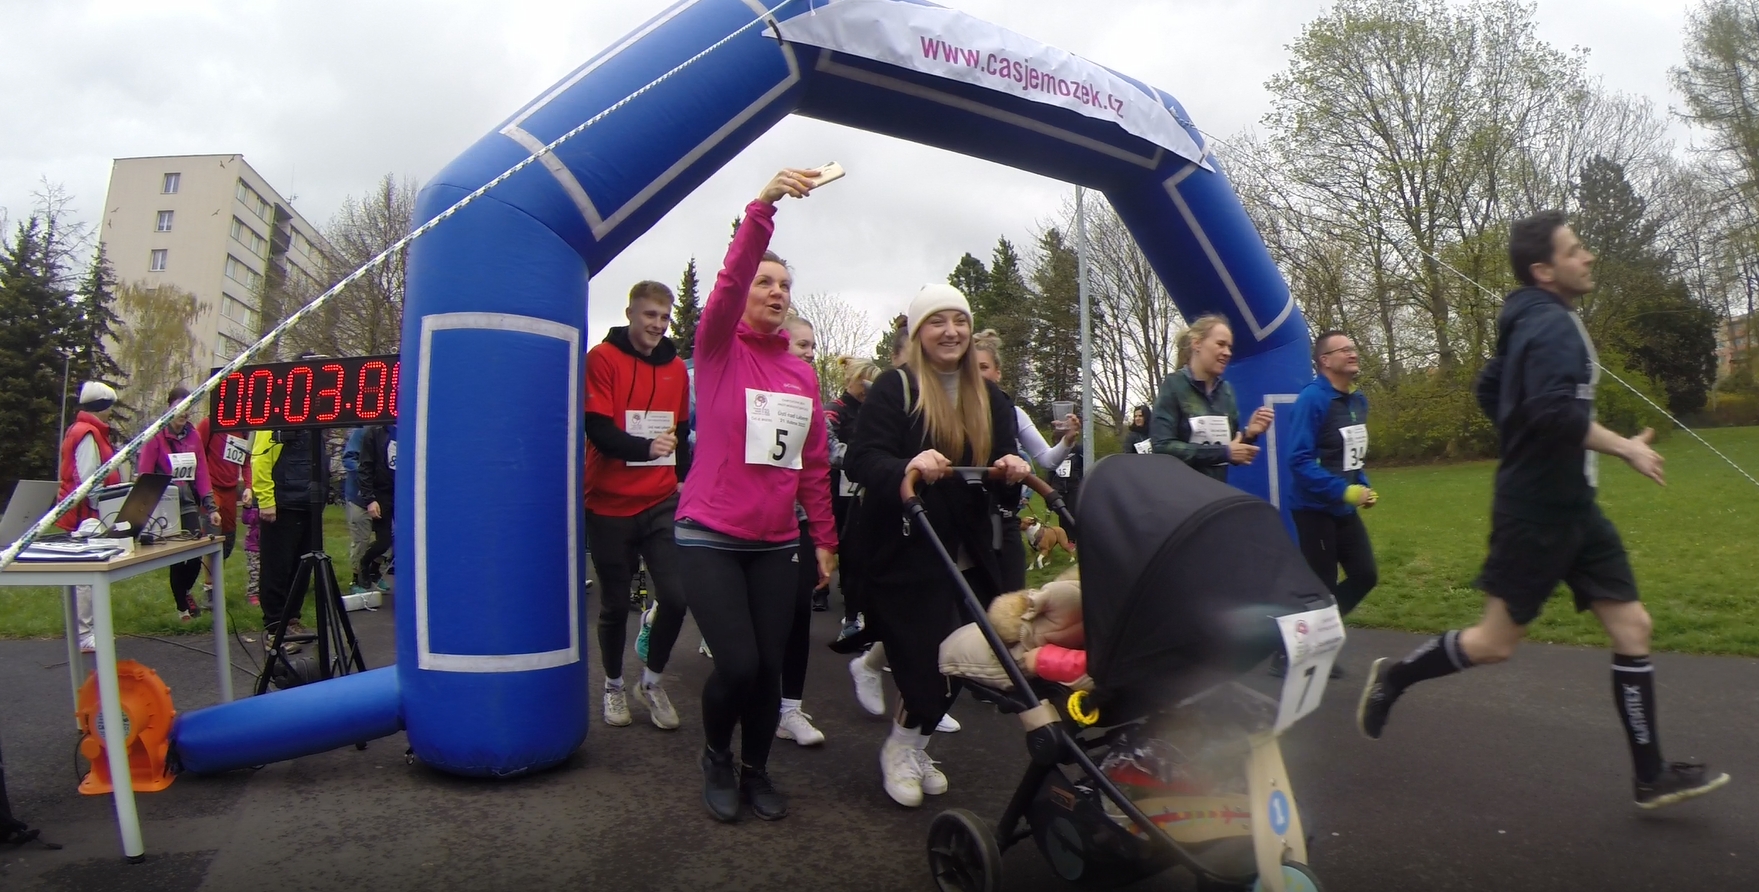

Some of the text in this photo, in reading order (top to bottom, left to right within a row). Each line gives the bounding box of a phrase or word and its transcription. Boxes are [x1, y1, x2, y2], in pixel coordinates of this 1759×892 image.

[920, 35, 1125, 119] www.casjemozek.cz
[225, 448, 244, 462] 102
[772, 428, 789, 461] 5
[173, 466, 193, 479] 101
